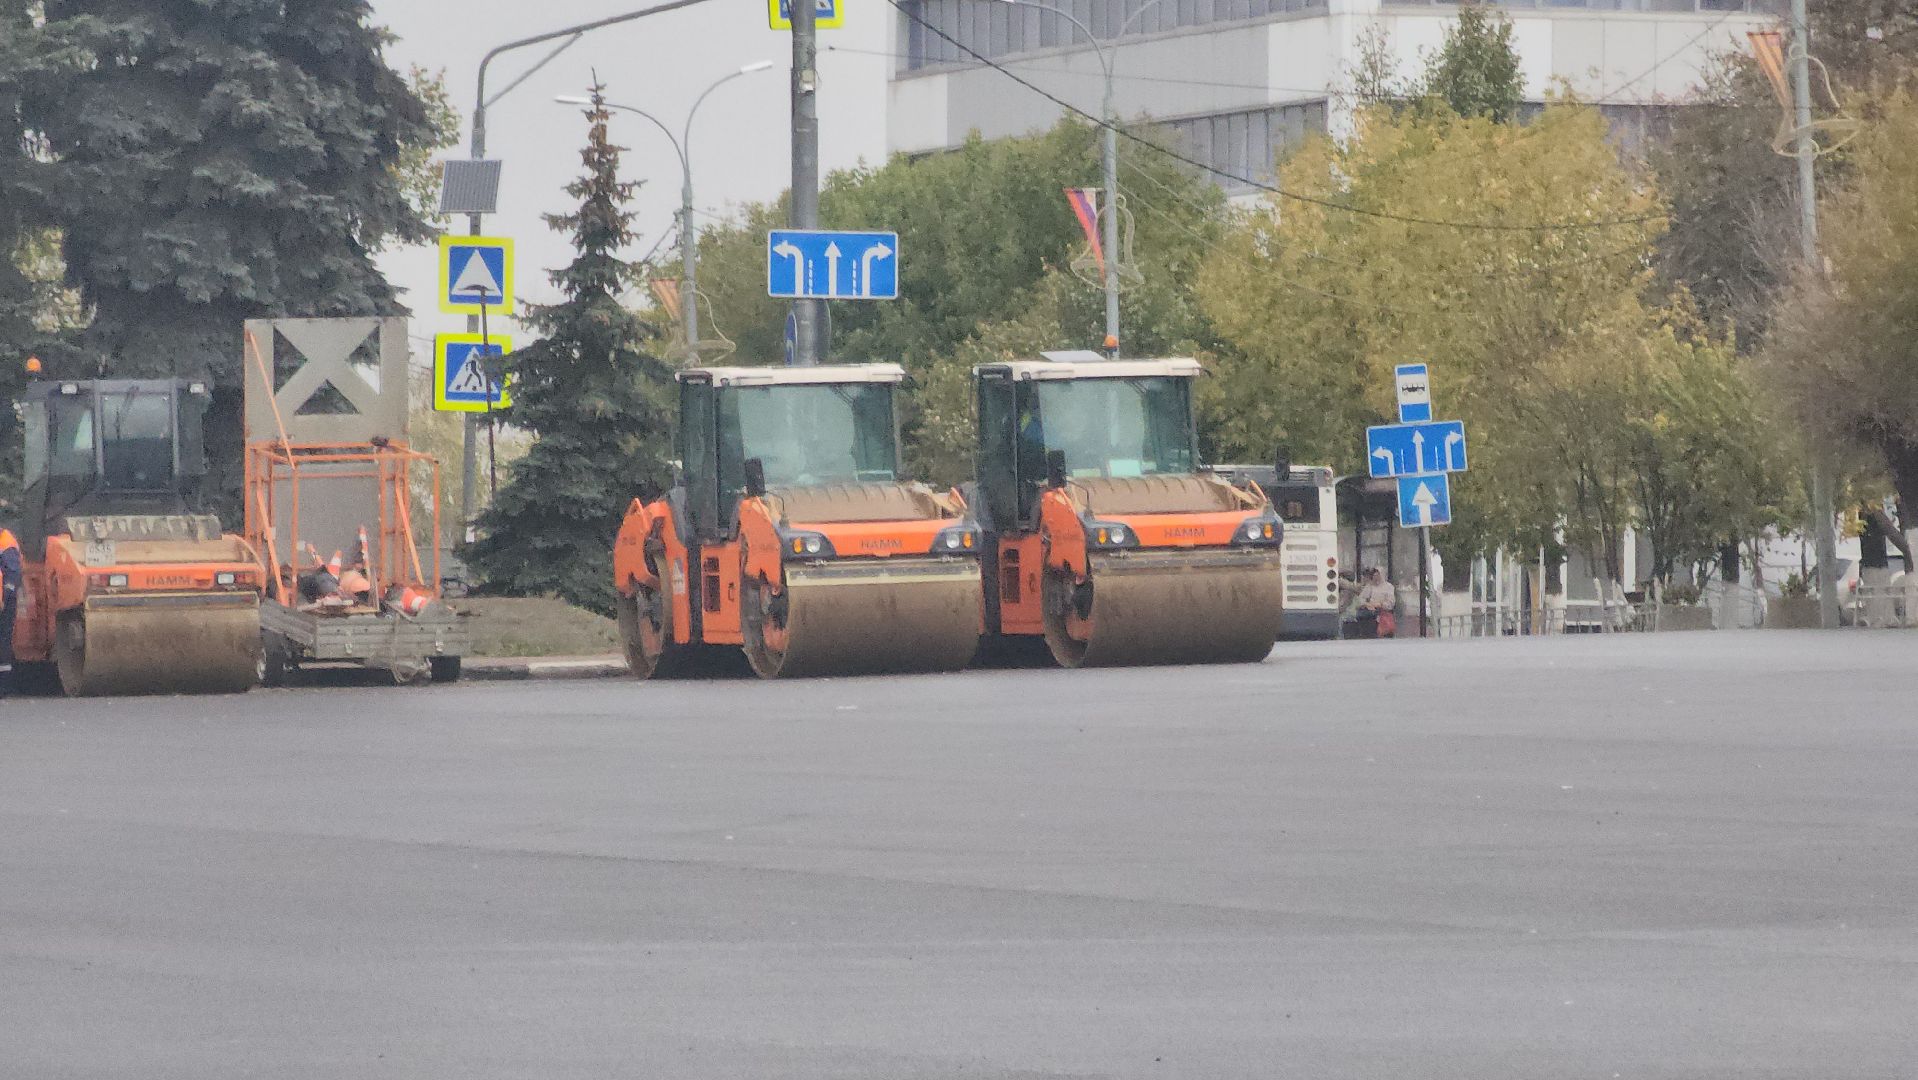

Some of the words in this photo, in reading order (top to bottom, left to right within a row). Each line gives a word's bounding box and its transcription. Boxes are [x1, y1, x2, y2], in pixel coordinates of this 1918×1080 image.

[1163, 527, 1205, 538] HAMM
[860, 539, 903, 549] HAMM
[145, 575, 192, 585] HAMM
